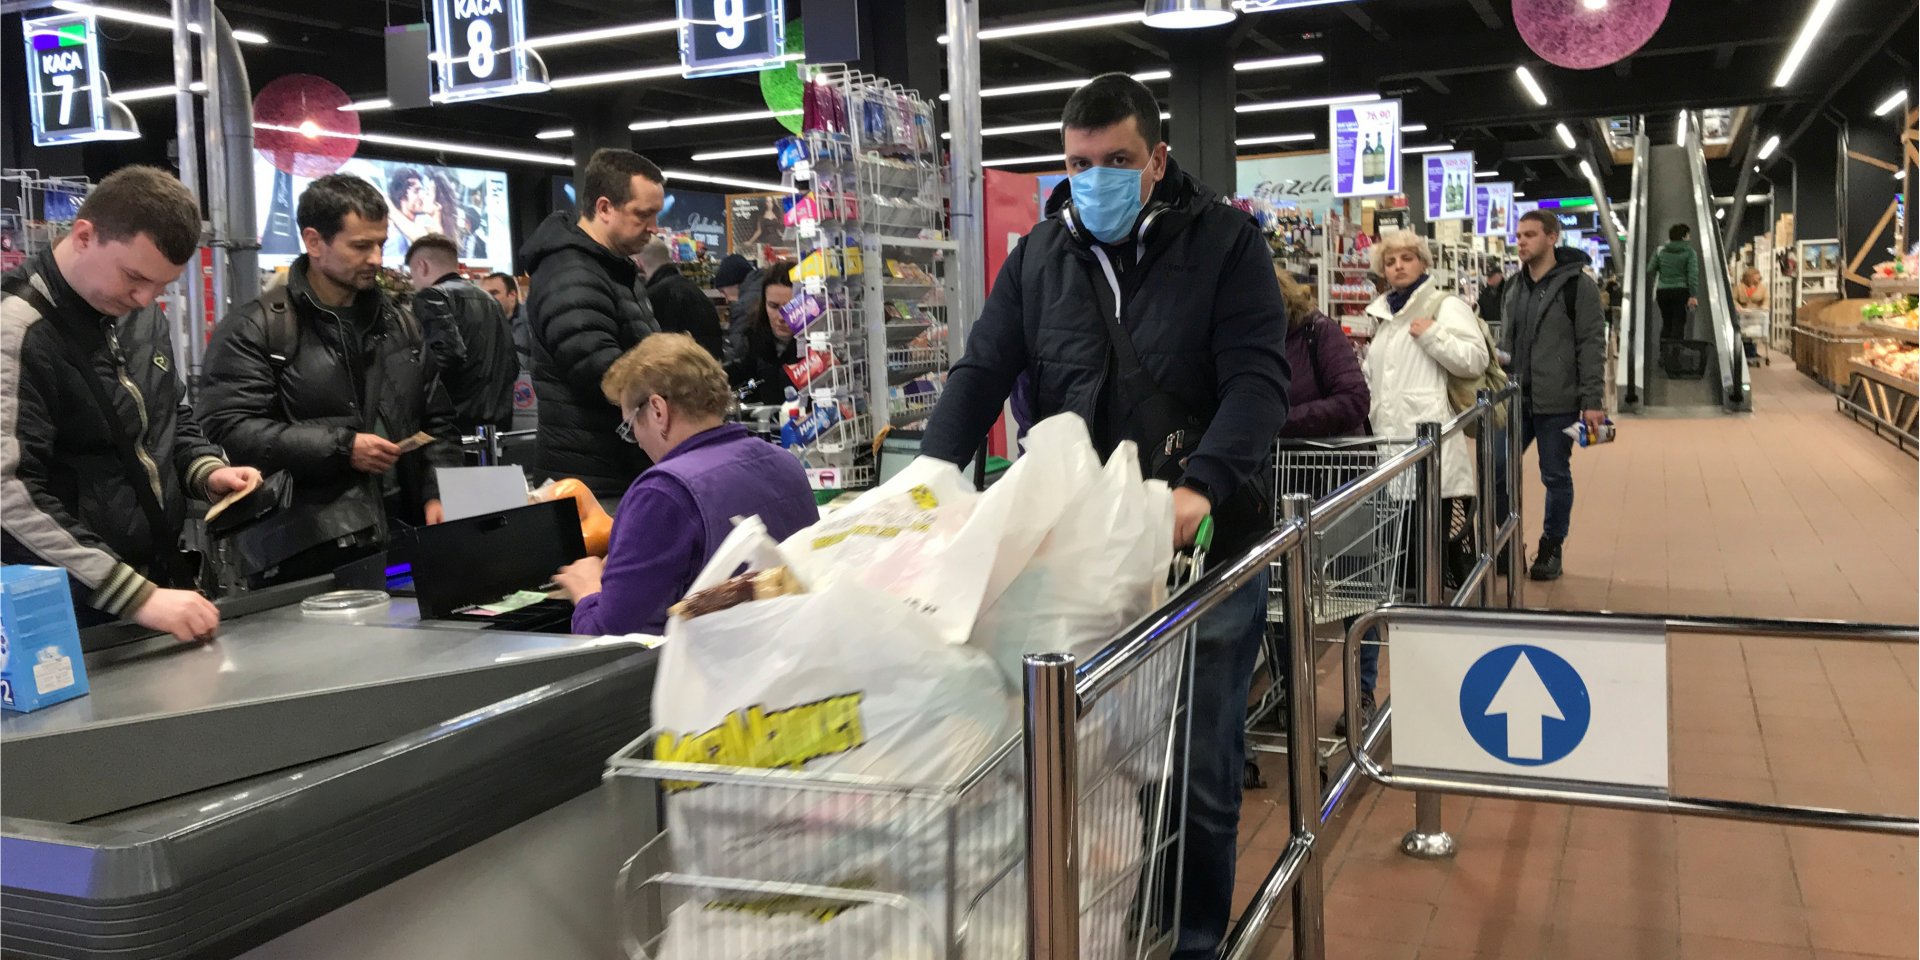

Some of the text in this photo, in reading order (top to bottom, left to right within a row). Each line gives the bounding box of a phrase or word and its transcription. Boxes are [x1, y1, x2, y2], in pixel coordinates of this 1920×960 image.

[454, 0, 503, 20] КАСА
[714, 0, 745, 50] 9
[42, 51, 83, 74] КАСА
[467, 19, 495, 79] 8
[52, 74, 74, 126] 7
